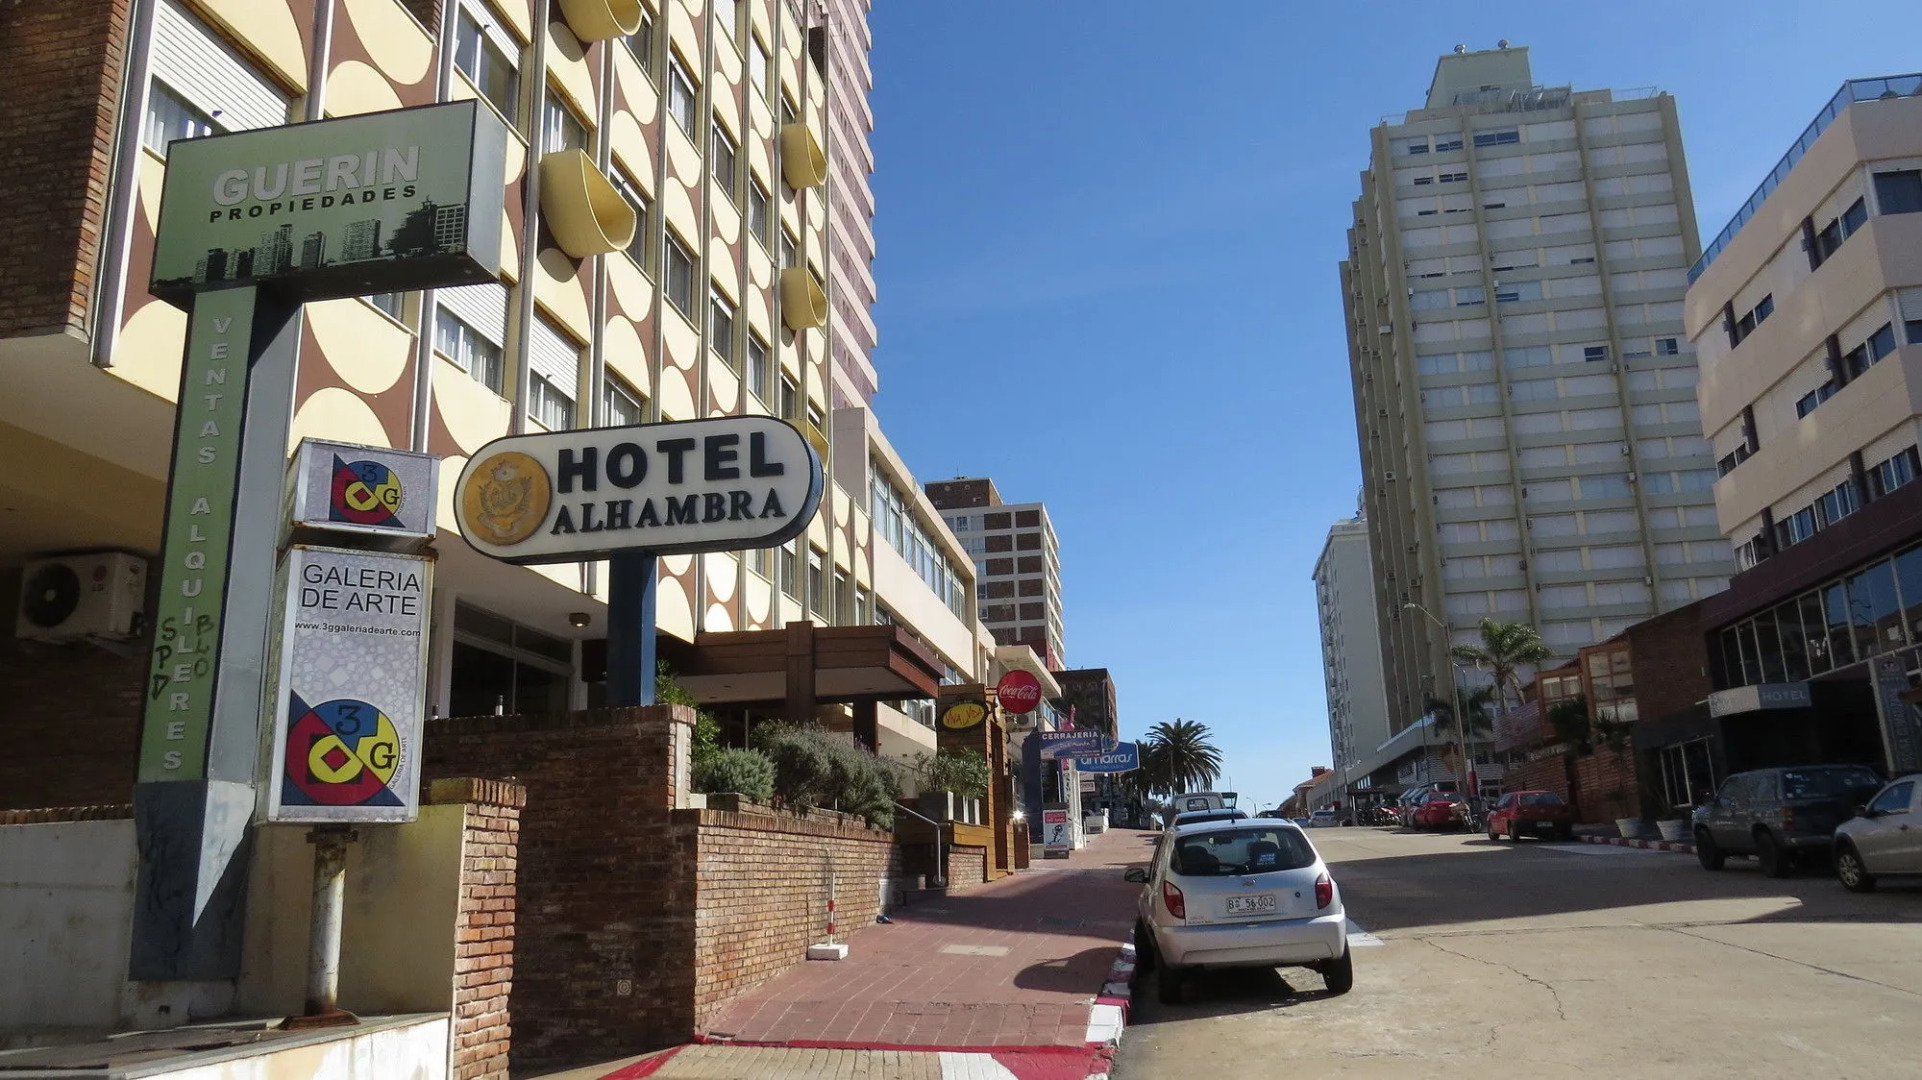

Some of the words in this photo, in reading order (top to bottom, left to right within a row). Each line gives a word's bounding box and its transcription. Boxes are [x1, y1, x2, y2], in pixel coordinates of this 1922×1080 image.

[212, 145, 422, 207] GUERIN
[209, 184, 417, 224] PROPIEDADES
[198, 316, 234, 466] VENTAS
[556, 431, 785, 494] HOTEL
[361, 463, 378, 484] 3
[383, 487, 401, 507] G
[550, 487, 787, 536] ALHAMBRA
[302, 563, 421, 593] GALERIA
[301, 587, 338, 611] DE
[345, 591, 418, 617] ARTE
[163, 496, 211, 771] ALQUILERES
[294, 620, 421, 638] www.3ggaleriadearte.com
[1762, 689, 1807, 701] HOTEL
[335, 704, 362, 736] 3
[369, 741, 397, 770] G
[1042, 731, 1099, 740] CERRAJERIA
